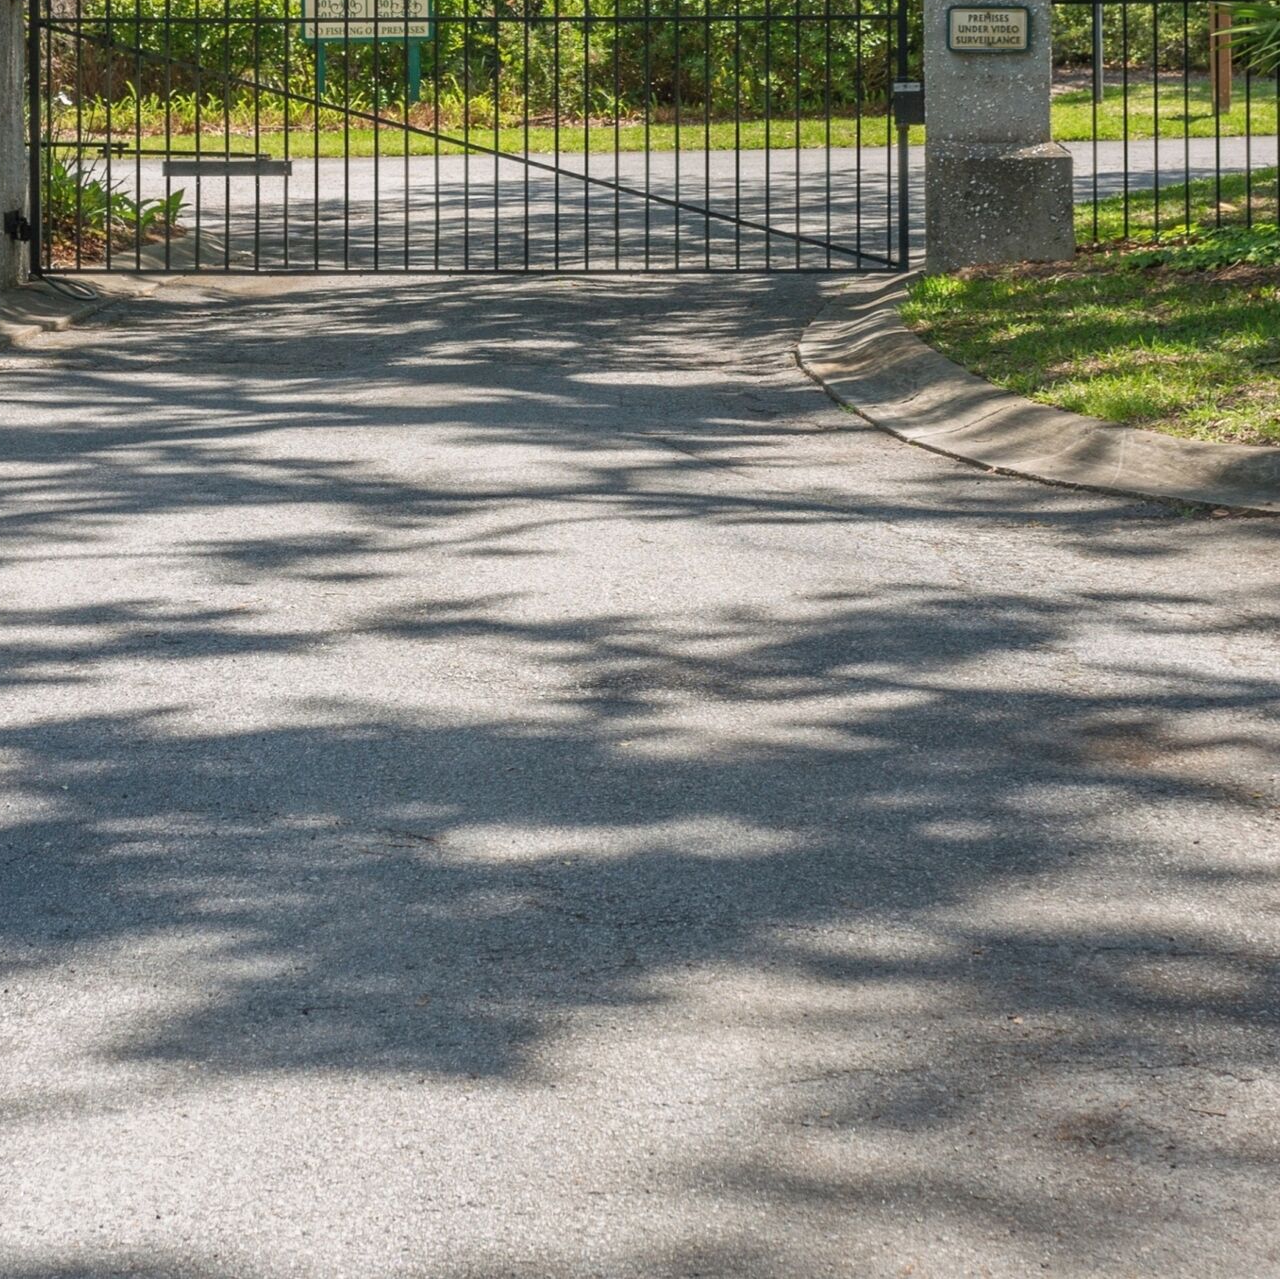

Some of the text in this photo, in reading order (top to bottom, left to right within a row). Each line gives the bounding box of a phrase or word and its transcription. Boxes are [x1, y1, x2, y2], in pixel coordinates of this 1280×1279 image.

[968, 14, 1009, 23] PREMISES
[326, 26, 363, 35] FISHNG
[381, 25, 426, 35] PREMSES
[958, 25, 1019, 33] UNDER VIDEO
[956, 35, 1020, 45] SURVEILLANCE
